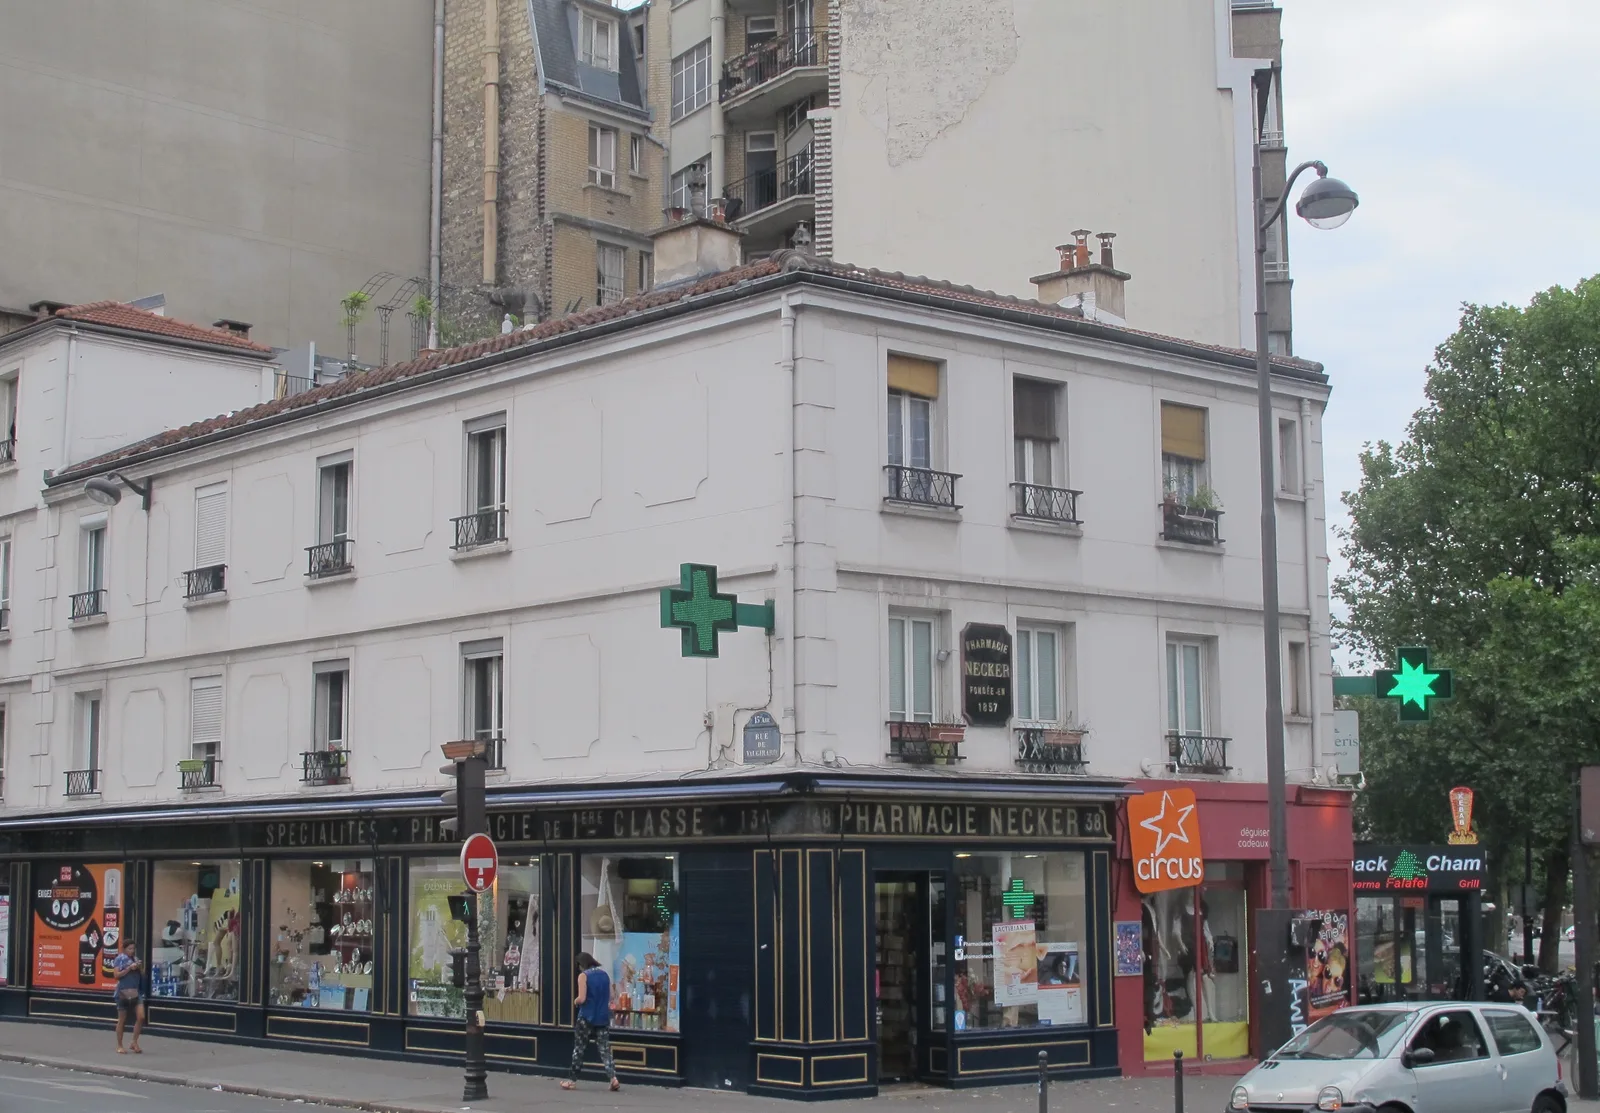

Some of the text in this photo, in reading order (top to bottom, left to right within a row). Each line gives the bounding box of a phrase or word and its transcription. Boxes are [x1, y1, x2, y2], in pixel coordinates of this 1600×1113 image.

[965, 639, 1009, 654] PHARMACIE
[965, 661, 1010, 678] NECKER
[978, 702, 998, 712] 1857
[755, 732, 768, 740] RUE
[1457, 792, 1465, 826] KEBAB
[544, 820, 561, 838] DE
[614, 808, 703, 837] CLASSE
[840, 803, 977, 835] PHARMACIE
[990, 807, 1080, 836] NECKER
[1084, 811, 1101, 832] 38
[1237, 838, 1269, 848] cadeaux
[1137, 852, 1202, 880] circus
[1426, 855, 1481, 872] Cham
[1386, 877, 1429, 889] Falafel
[1458, 879, 1480, 888] Grill
